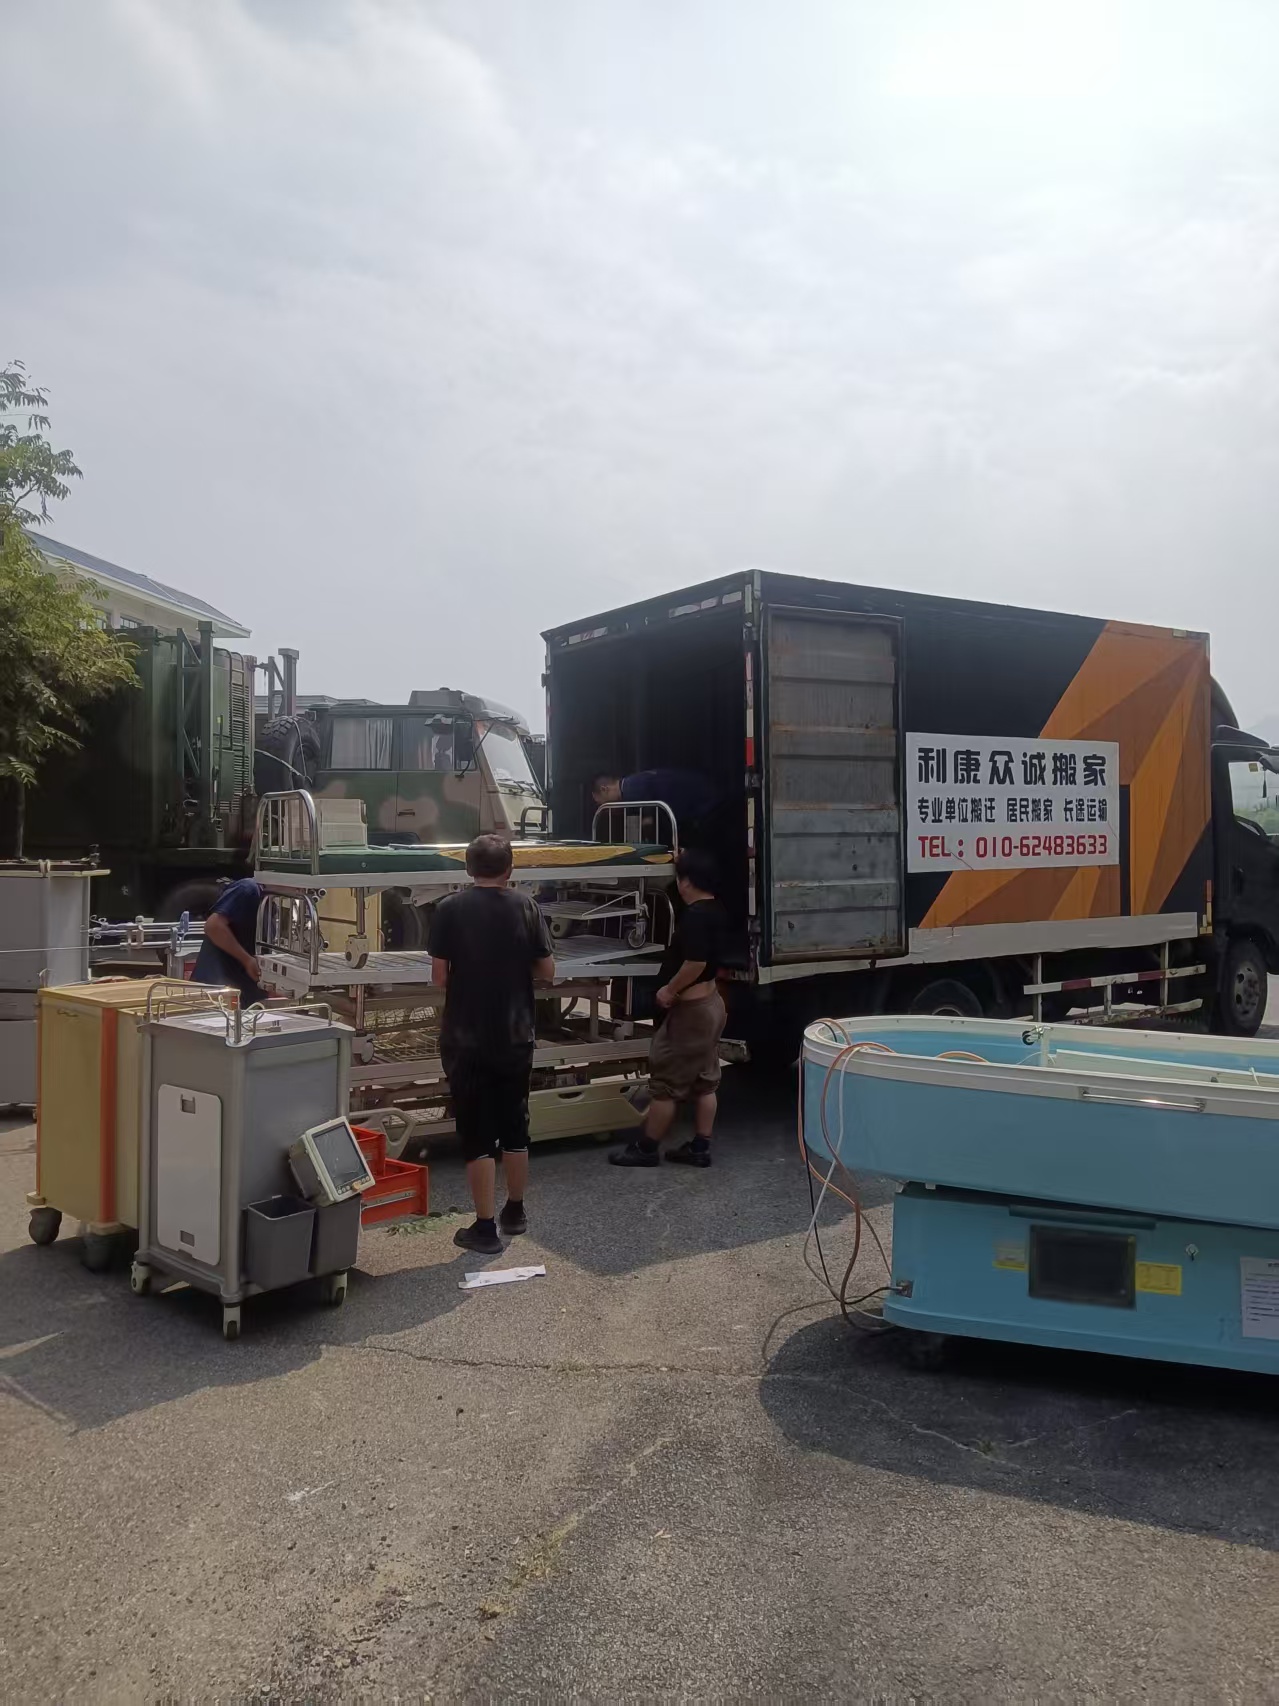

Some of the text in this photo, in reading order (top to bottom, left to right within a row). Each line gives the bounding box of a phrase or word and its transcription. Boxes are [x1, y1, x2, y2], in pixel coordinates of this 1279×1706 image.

[917, 747, 1107, 787] 利康众诚搬家
[917, 797, 1108, 823] 专业单位搬迁 居民搬家 长途运输
[975, 834, 1108, 858] 010-62483633
